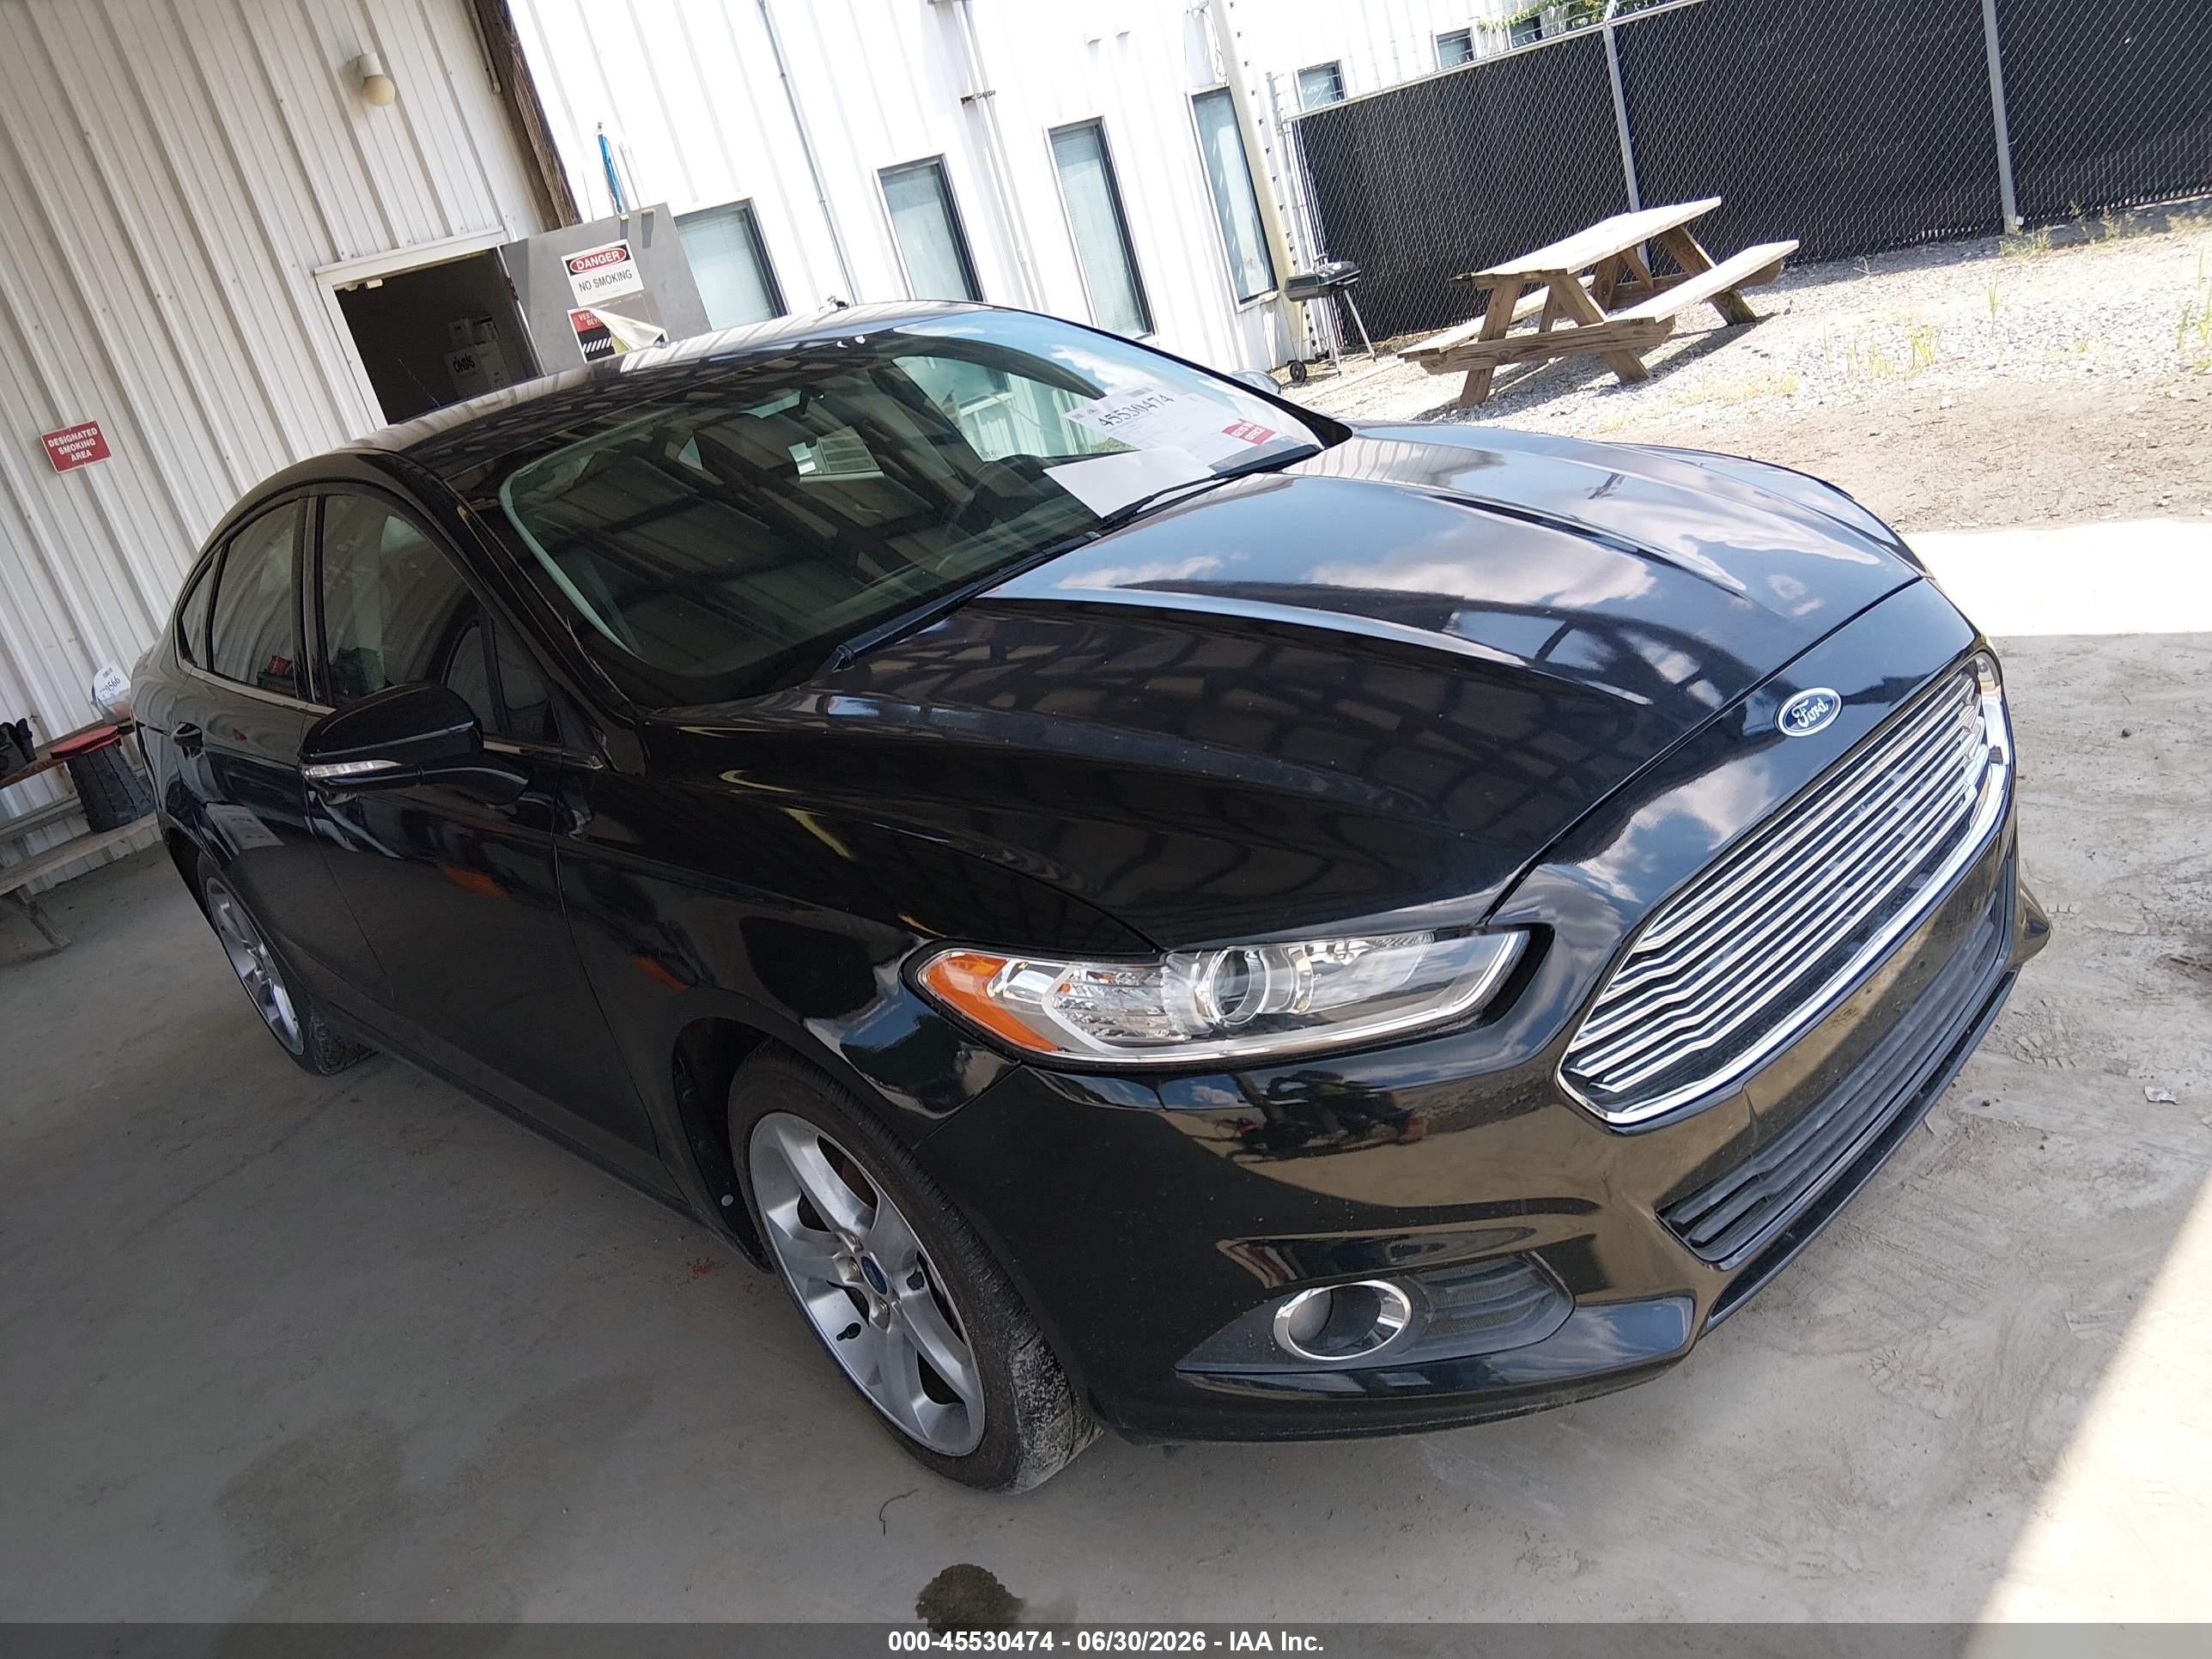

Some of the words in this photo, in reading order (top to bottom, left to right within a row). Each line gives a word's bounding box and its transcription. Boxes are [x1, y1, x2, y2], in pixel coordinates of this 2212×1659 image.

[575, 250, 621, 270] DANGER
[578, 280, 592, 293] NO
[593, 269, 633, 289] SMOKING
[586, 318, 601, 326] BEY
[1098, 394, 1175, 426] 45530474
[47, 427, 98, 448] DESIGNATED
[58, 438, 96, 455] SMOKING
[70, 449, 93, 462] AREA
[1790, 697, 1829, 728] Ford
